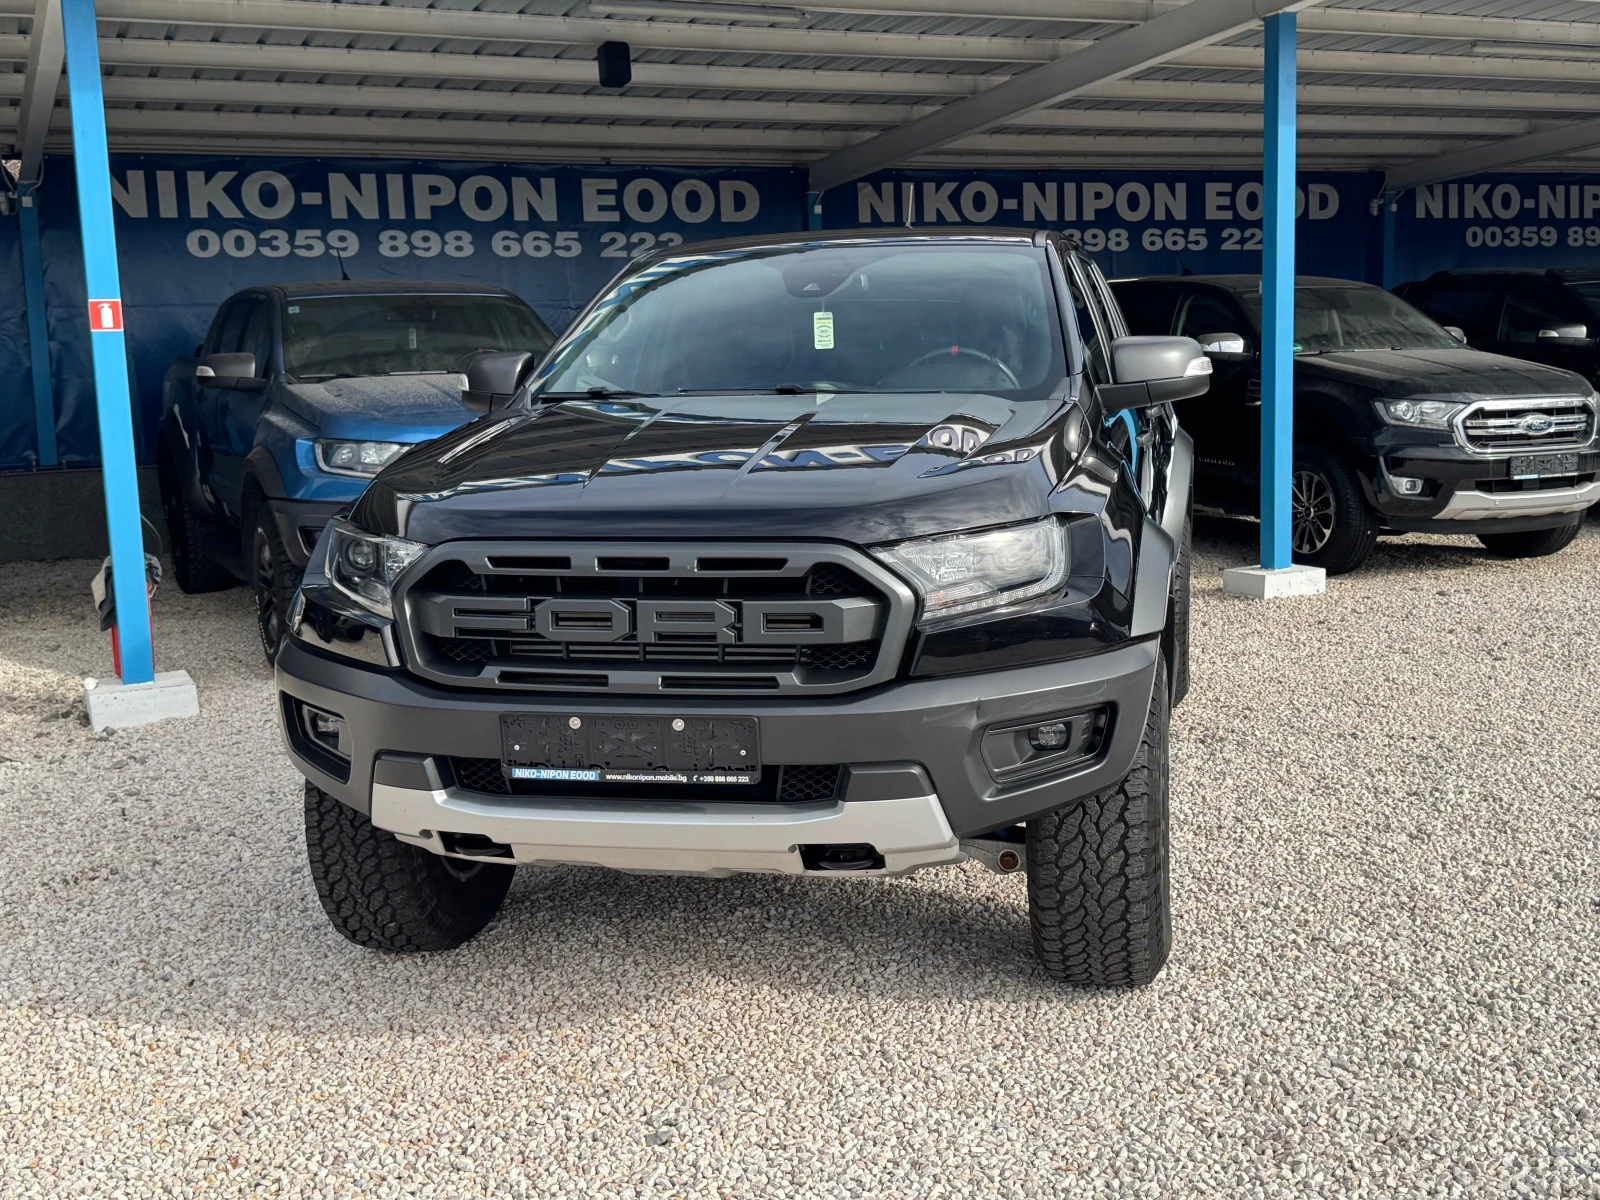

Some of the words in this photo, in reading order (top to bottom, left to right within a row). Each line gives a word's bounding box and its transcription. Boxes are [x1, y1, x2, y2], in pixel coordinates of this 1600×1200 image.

[112, 170, 558, 222] NIKO-NIPON
[581, 178, 760, 223] EOOD
[857, 180, 1187, 222] NIKO-NIPON
[1205, 182, 1340, 221] EOD
[186, 229, 360, 258] 00359
[378, 230, 474, 258] 898
[491, 230, 582, 258] 665
[1142, 228, 1208, 252] 665
[1465, 226, 1558, 248] 00359
[430, 597, 866, 644] FORD
[514, 768, 569, 780] NIKO-NIPON
[570, 770, 597, 780] EOOD
[605, 773, 688, 783] www.nikonipon.mobile.bg
